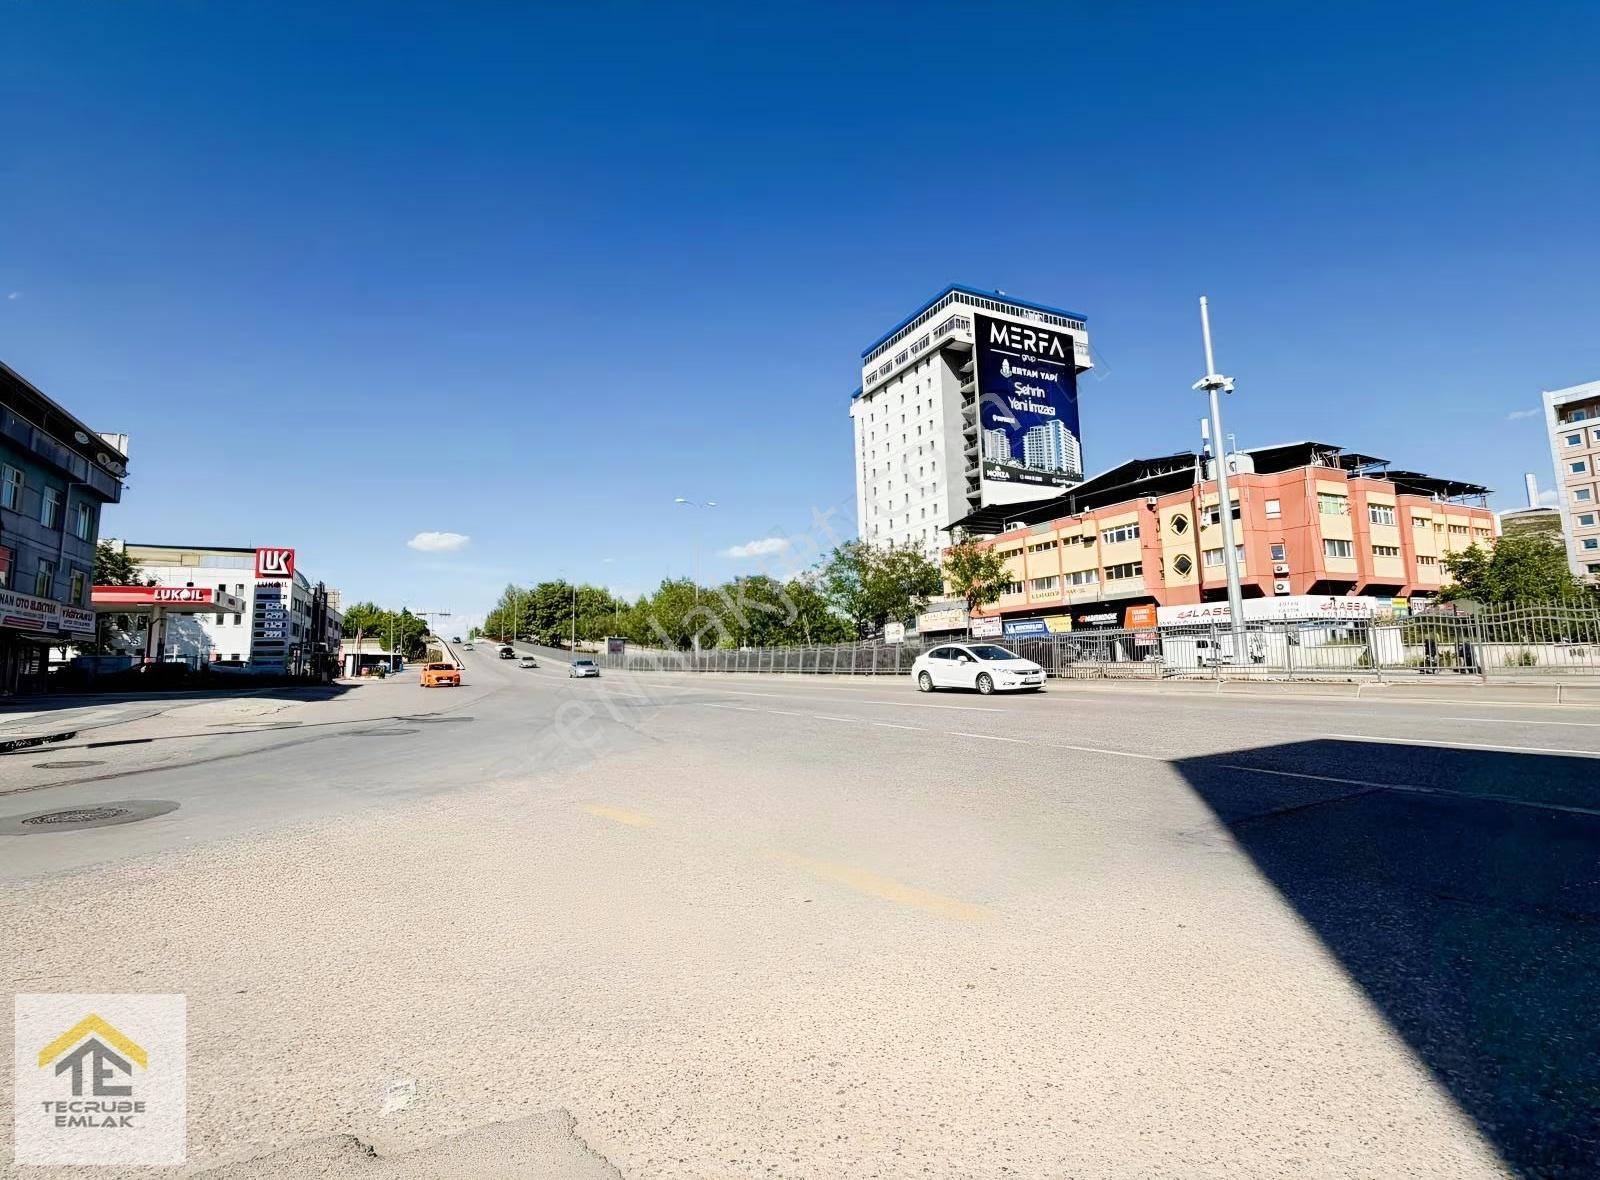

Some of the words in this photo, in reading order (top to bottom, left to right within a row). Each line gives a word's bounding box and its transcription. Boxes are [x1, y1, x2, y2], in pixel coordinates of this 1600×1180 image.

[990, 322, 1064, 358] MERFA
[1014, 381, 1045, 399] Şehrin
[1008, 396, 1028, 412] Yeni
[153, 589, 204, 601] LUKOIL
[16, 597, 29, 609] OTO
[1192, 607, 1232, 617] LASS
